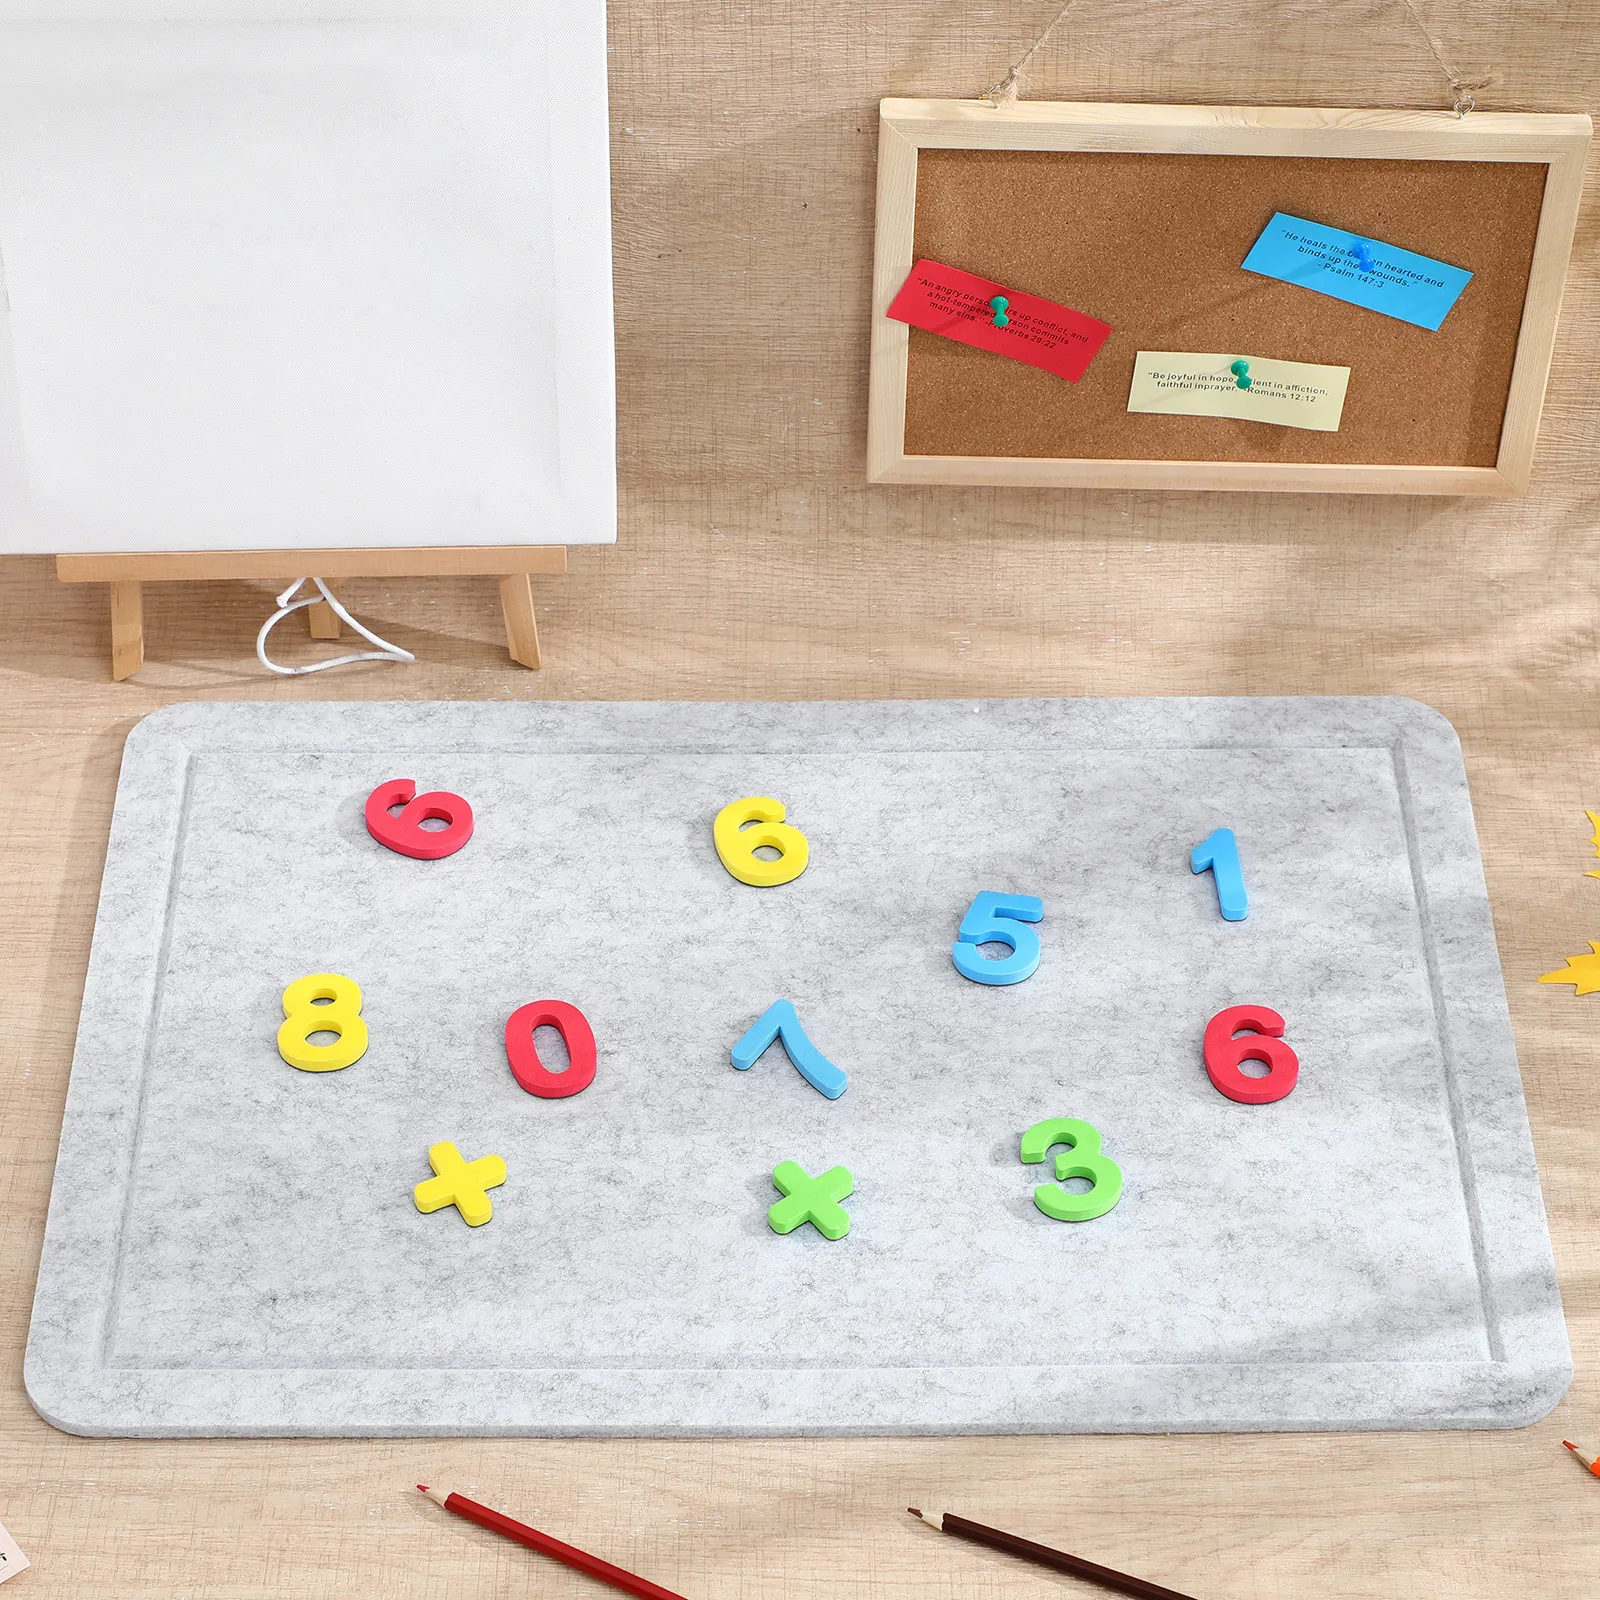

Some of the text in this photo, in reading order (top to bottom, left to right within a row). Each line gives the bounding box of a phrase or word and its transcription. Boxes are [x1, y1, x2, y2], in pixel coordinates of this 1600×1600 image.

[1297, 245, 1327, 260] binds
[1328, 255, 1341, 265] up
[1300, 235, 1328, 250] heals
[1329, 244, 1346, 255] the
[1357, 273, 1385, 288] 147:3
[1385, 261, 1445, 288] hearted and
[926, 291, 934, 299] a
[1030, 324, 1070, 346] commits
[928, 300, 956, 315] many
[1030, 337, 1056, 349] 29:22
[935, 283, 963, 299] angry
[963, 292, 993, 308] perso
[1019, 311, 1031, 321] up
[1031, 315, 1069, 336] conflict,
[1070, 332, 1089, 344] and
[1156, 380, 1193, 389] faithful
[1290, 393, 1317, 403] 12:12
[1166, 372, 1196, 383] joyful
[1198, 373, 1208, 381] in
[1273, 381, 1283, 389] in
[365, 779, 473, 860] 6
[714, 797, 808, 887] 6
[1191, 828, 1248, 922] 1
[953, 891, 1043, 985] 5
[278, 974, 368, 1072] 8
[1203, 1005, 1299, 1104] 6
[1022, 1118, 1121, 1221] 3
